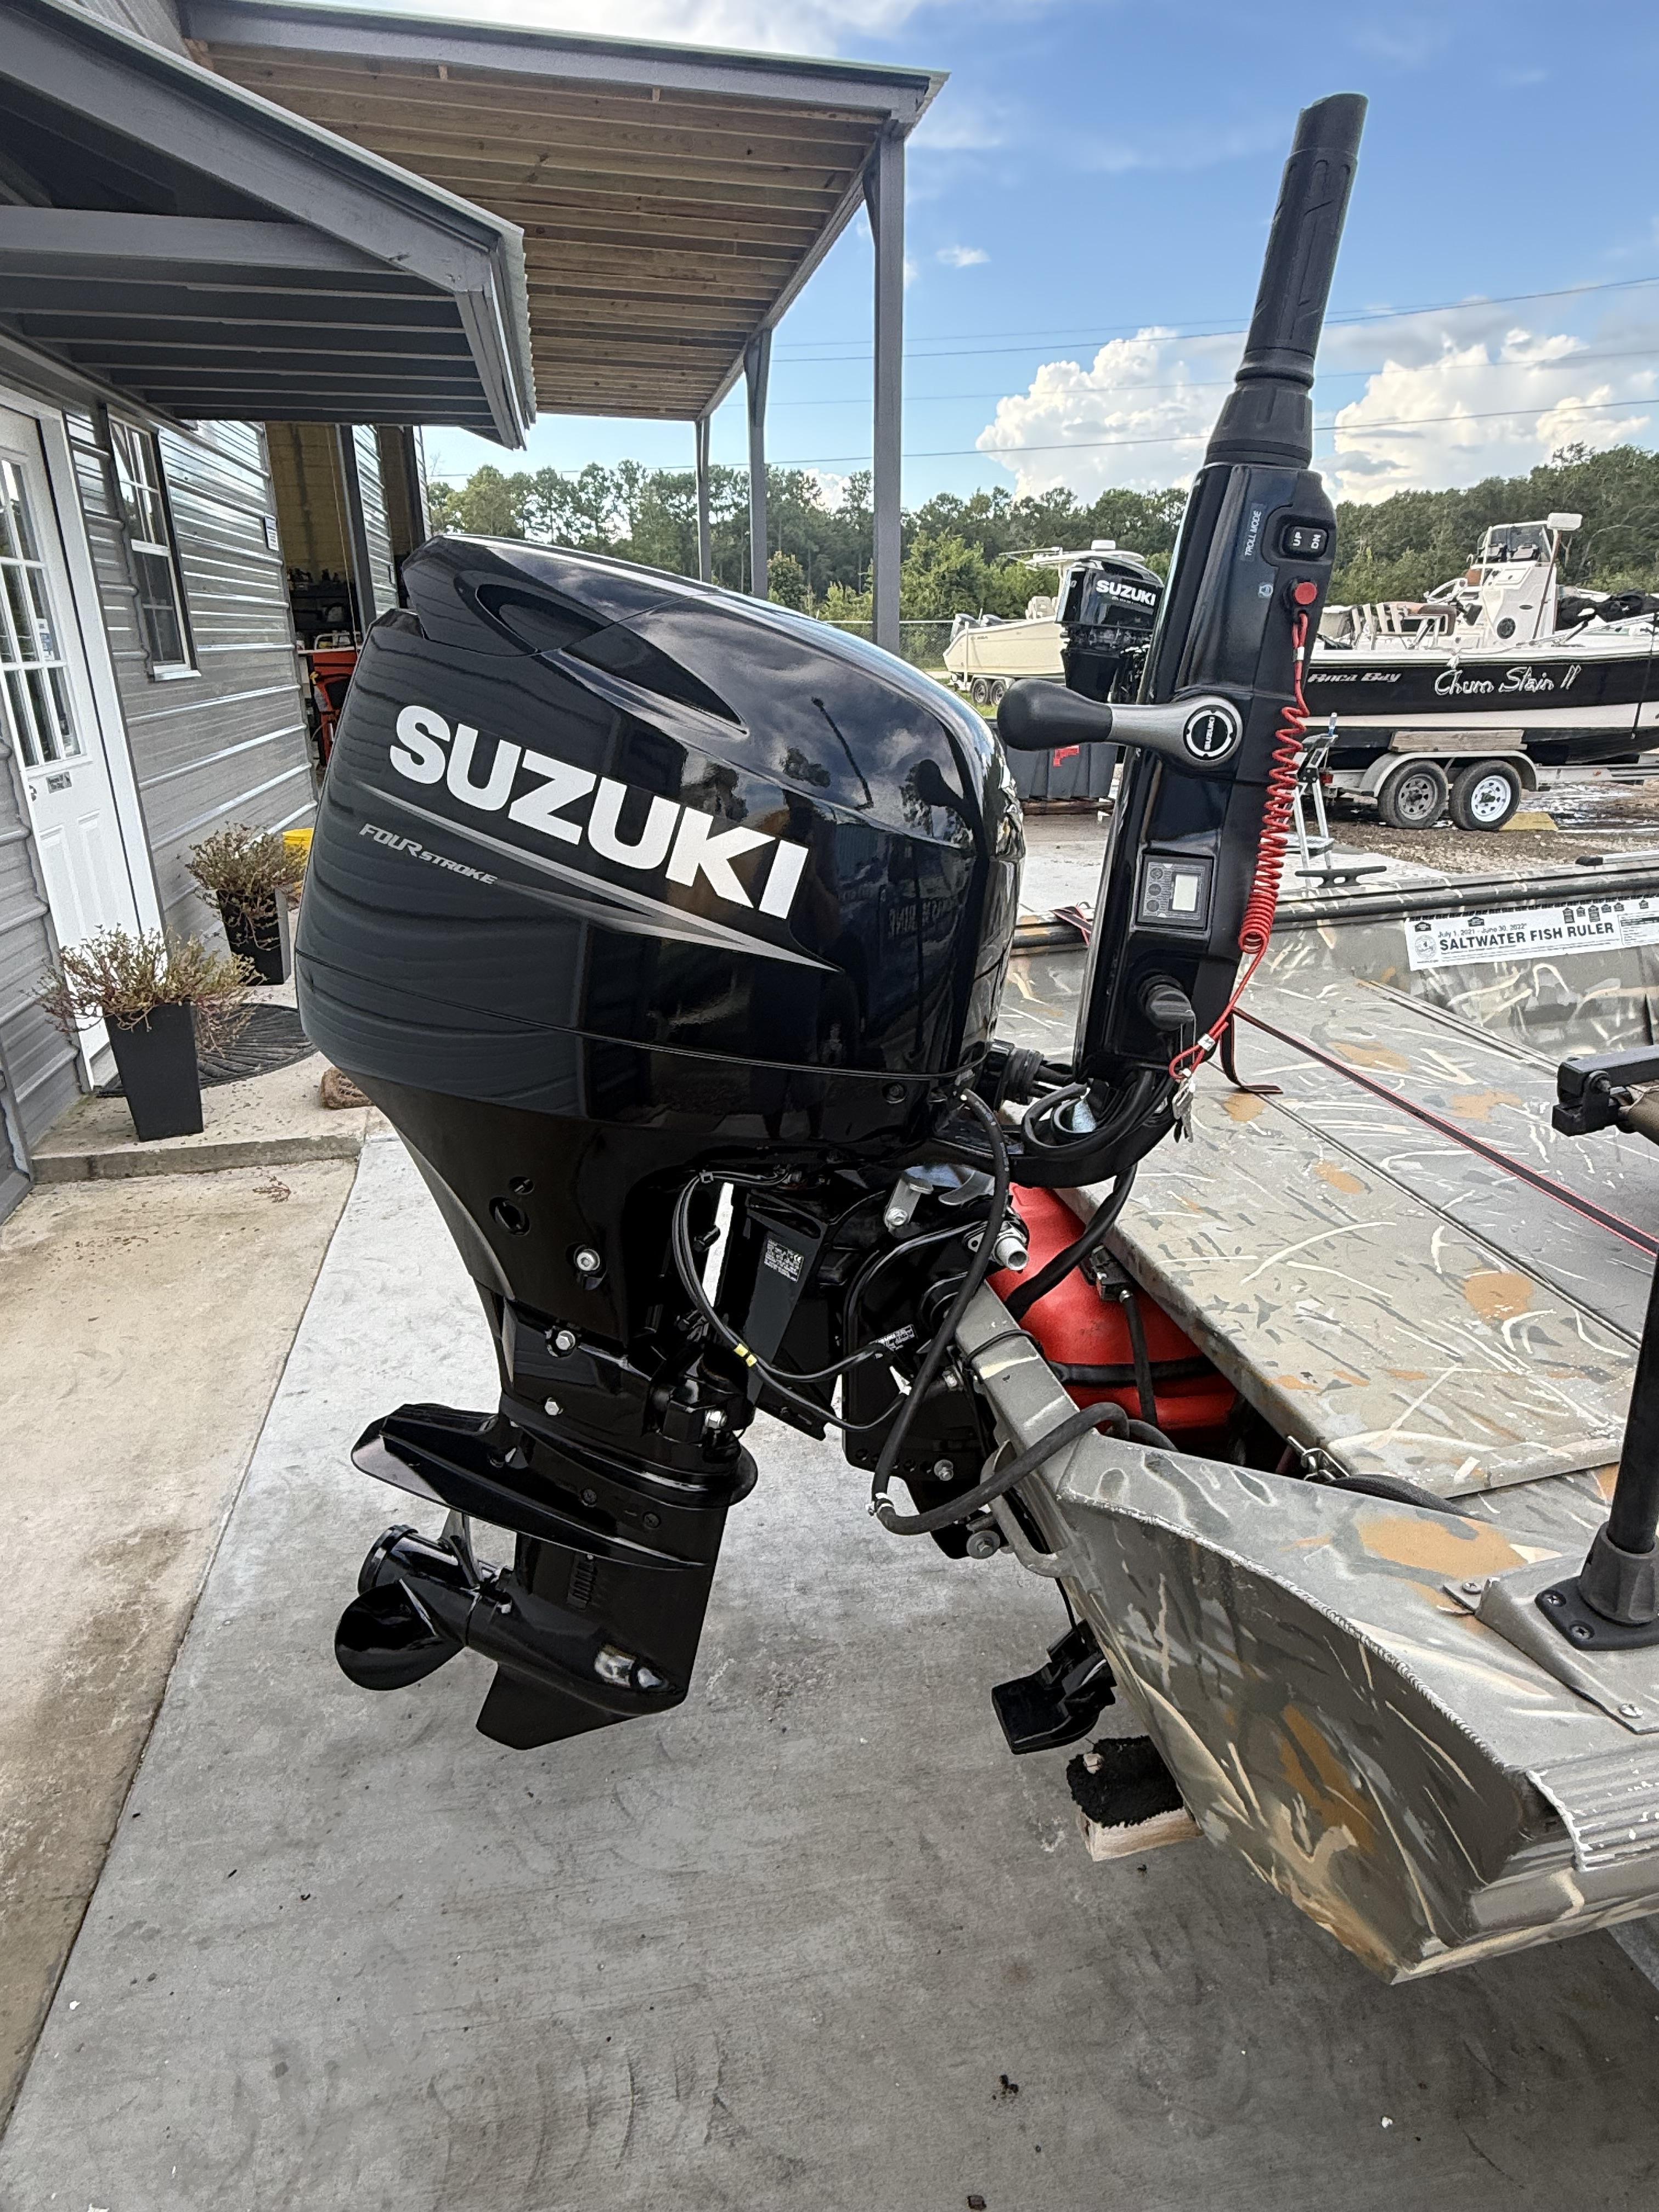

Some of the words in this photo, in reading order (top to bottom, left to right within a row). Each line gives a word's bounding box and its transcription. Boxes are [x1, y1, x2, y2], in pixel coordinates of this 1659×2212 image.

[1250, 510, 1261, 533] MODE
[1245, 534, 1256, 556] TROLL
[1293, 532, 1302, 546] UP
[1311, 534, 1321, 549] DN
[1096, 579, 1156, 606] SUZUKI
[1361, 673, 1401, 682] Bay
[1435, 669, 1494, 696] Chum
[390, 706, 809, 919] SUZUKI
[359, 823, 422, 857] FOUR
[418, 850, 498, 885] STROKE
[1440, 932, 1526, 951] SALTWATER
[1530, 927, 1563, 941] FISH
[1567, 922, 1614, 938] RULER
